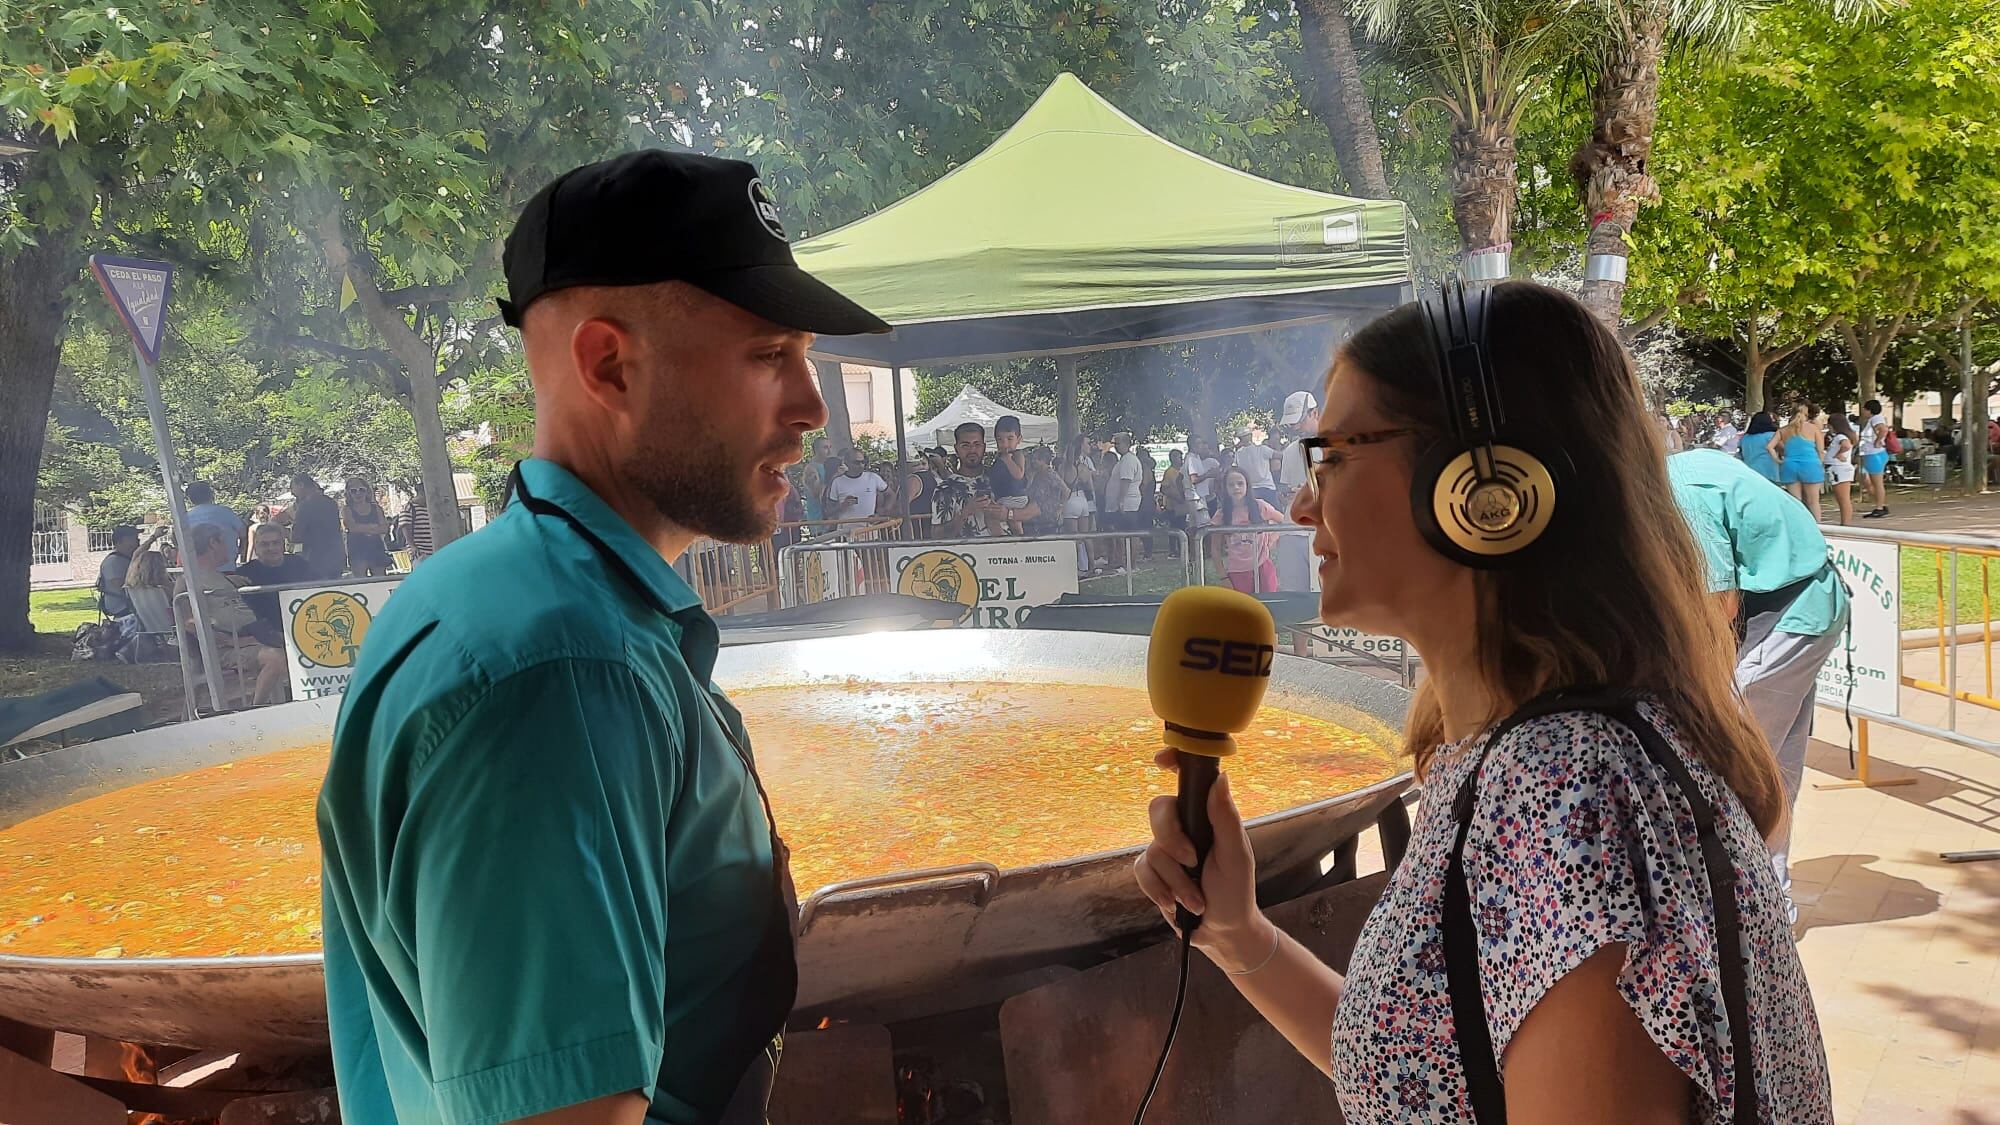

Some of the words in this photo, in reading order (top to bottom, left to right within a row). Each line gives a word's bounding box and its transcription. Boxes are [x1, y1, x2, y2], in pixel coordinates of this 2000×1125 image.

[110, 269, 131, 279] CEDA
[132, 272, 142, 280] EL
[142, 273, 162, 282] PASO
[1480, 508, 1511, 520] AKG
[988, 557, 1019, 565] TOTANA
[1025, 555, 1056, 564] MURCIA
[1825, 544, 1894, 610] GANTES
[979, 577, 1027, 601] EL
[1362, 638, 1403, 652] 968
[1815, 670, 1831, 682] 20
[1824, 658, 1886, 680] ol.com
[1818, 684, 1844, 698] URCIA
